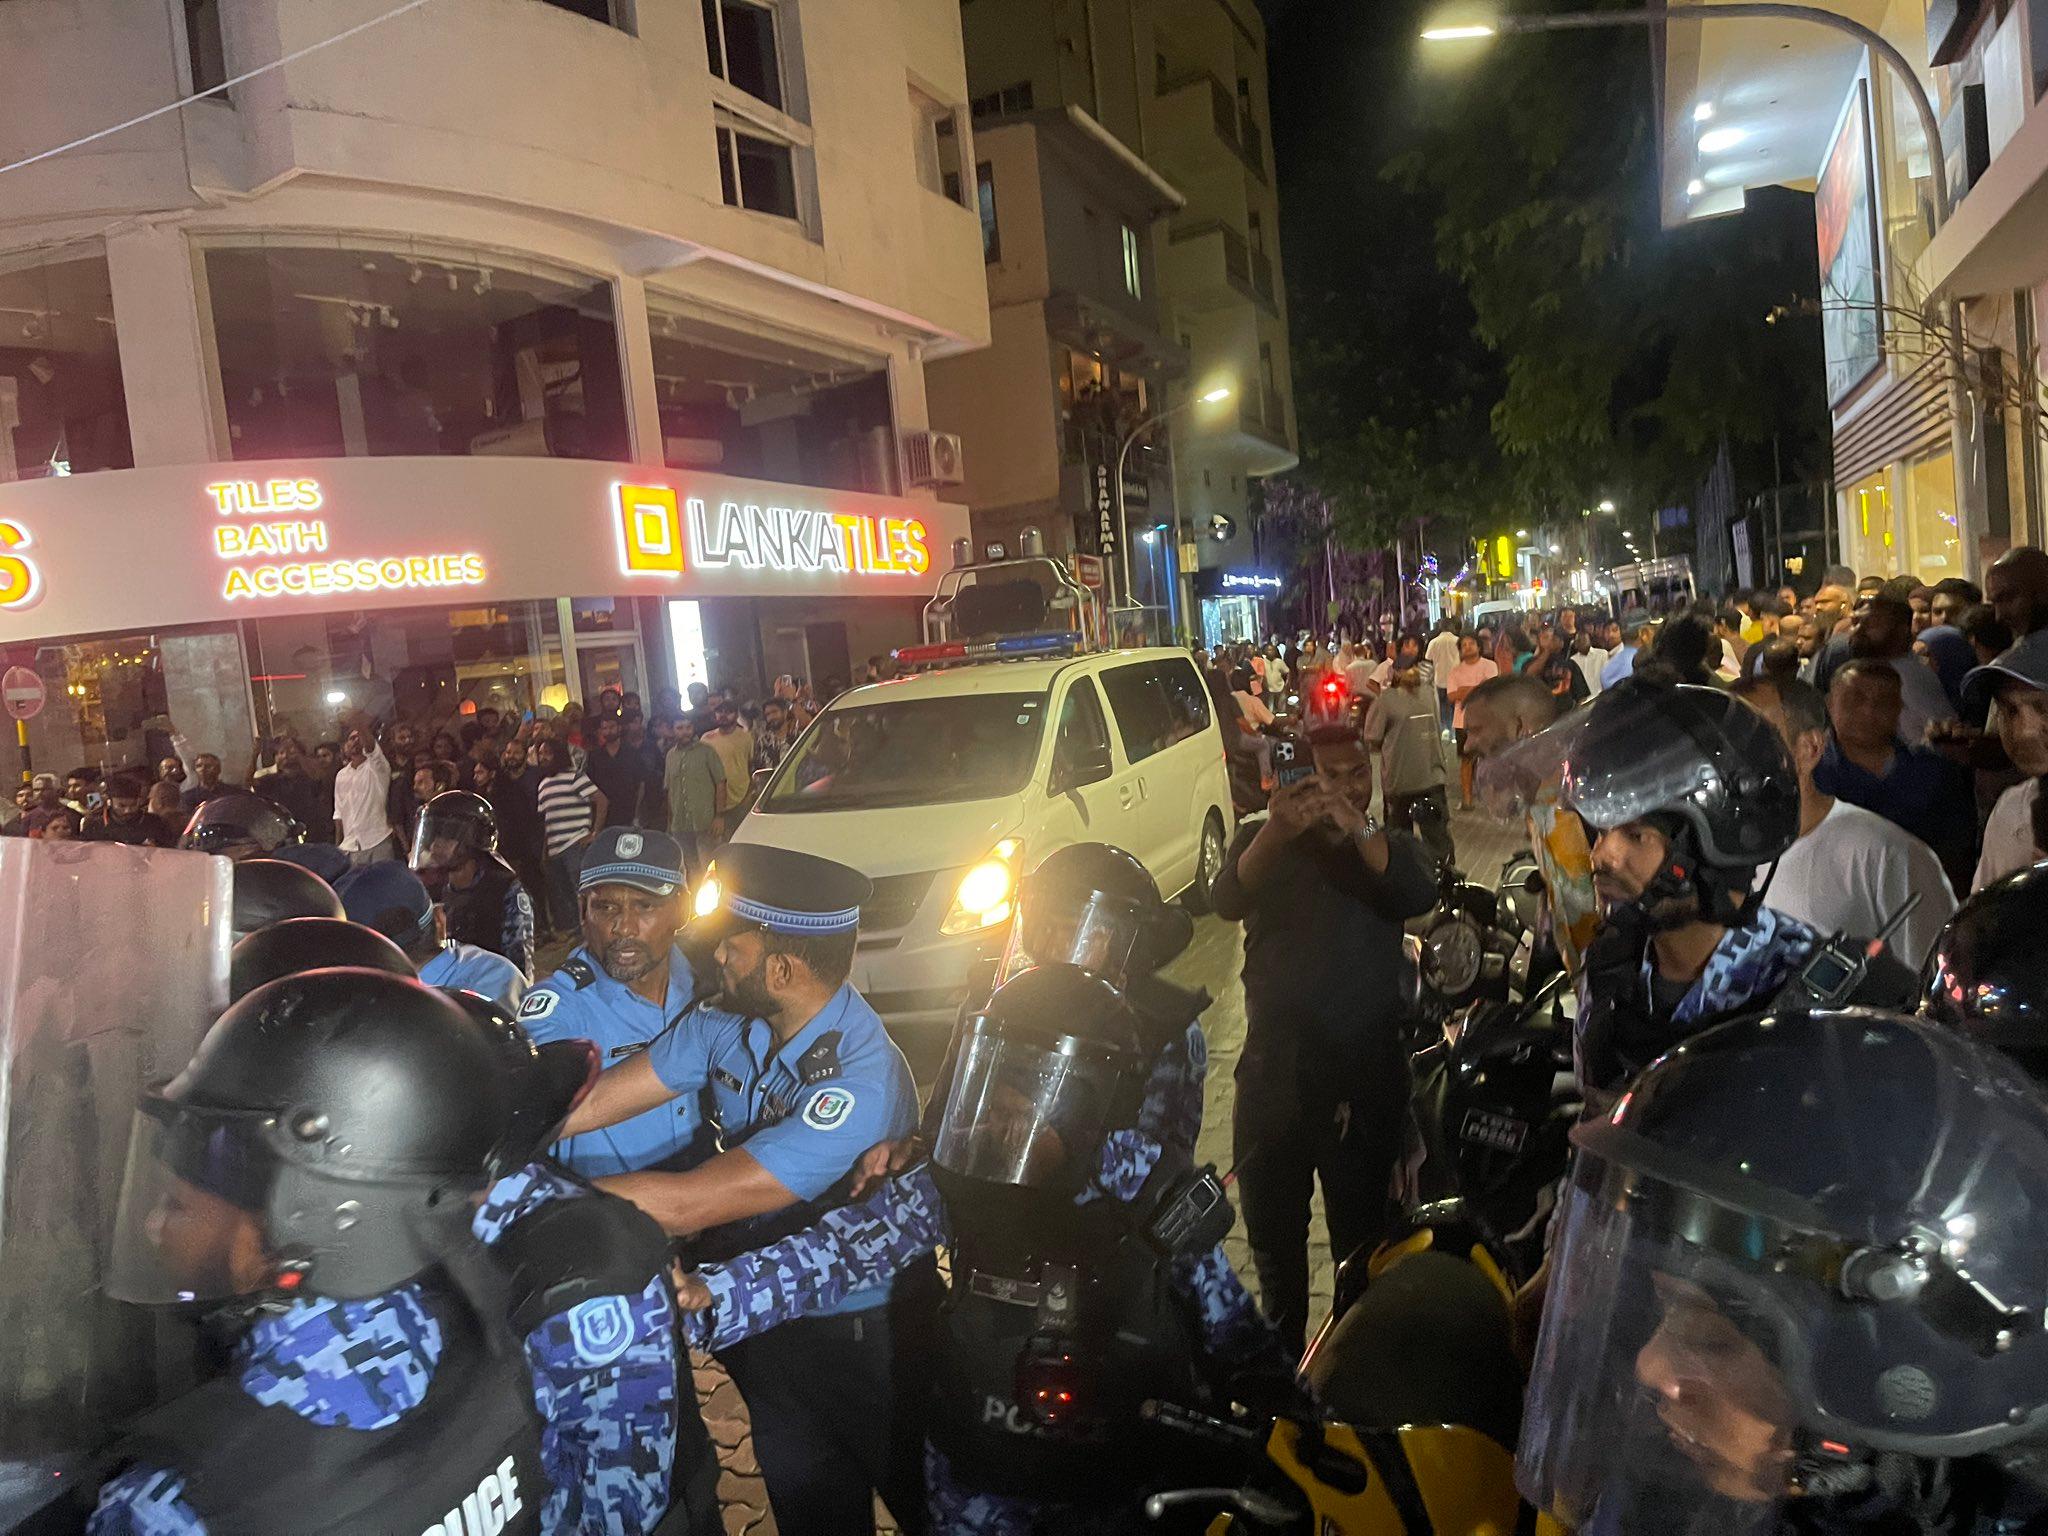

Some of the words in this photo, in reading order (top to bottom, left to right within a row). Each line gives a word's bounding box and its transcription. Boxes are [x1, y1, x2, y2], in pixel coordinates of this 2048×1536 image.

[207, 480, 322, 514] TILES
[216, 521, 327, 557] BATH
[688, 499, 930, 575] LANKATILES
[224, 554, 487, 600] ACCESSORIES
